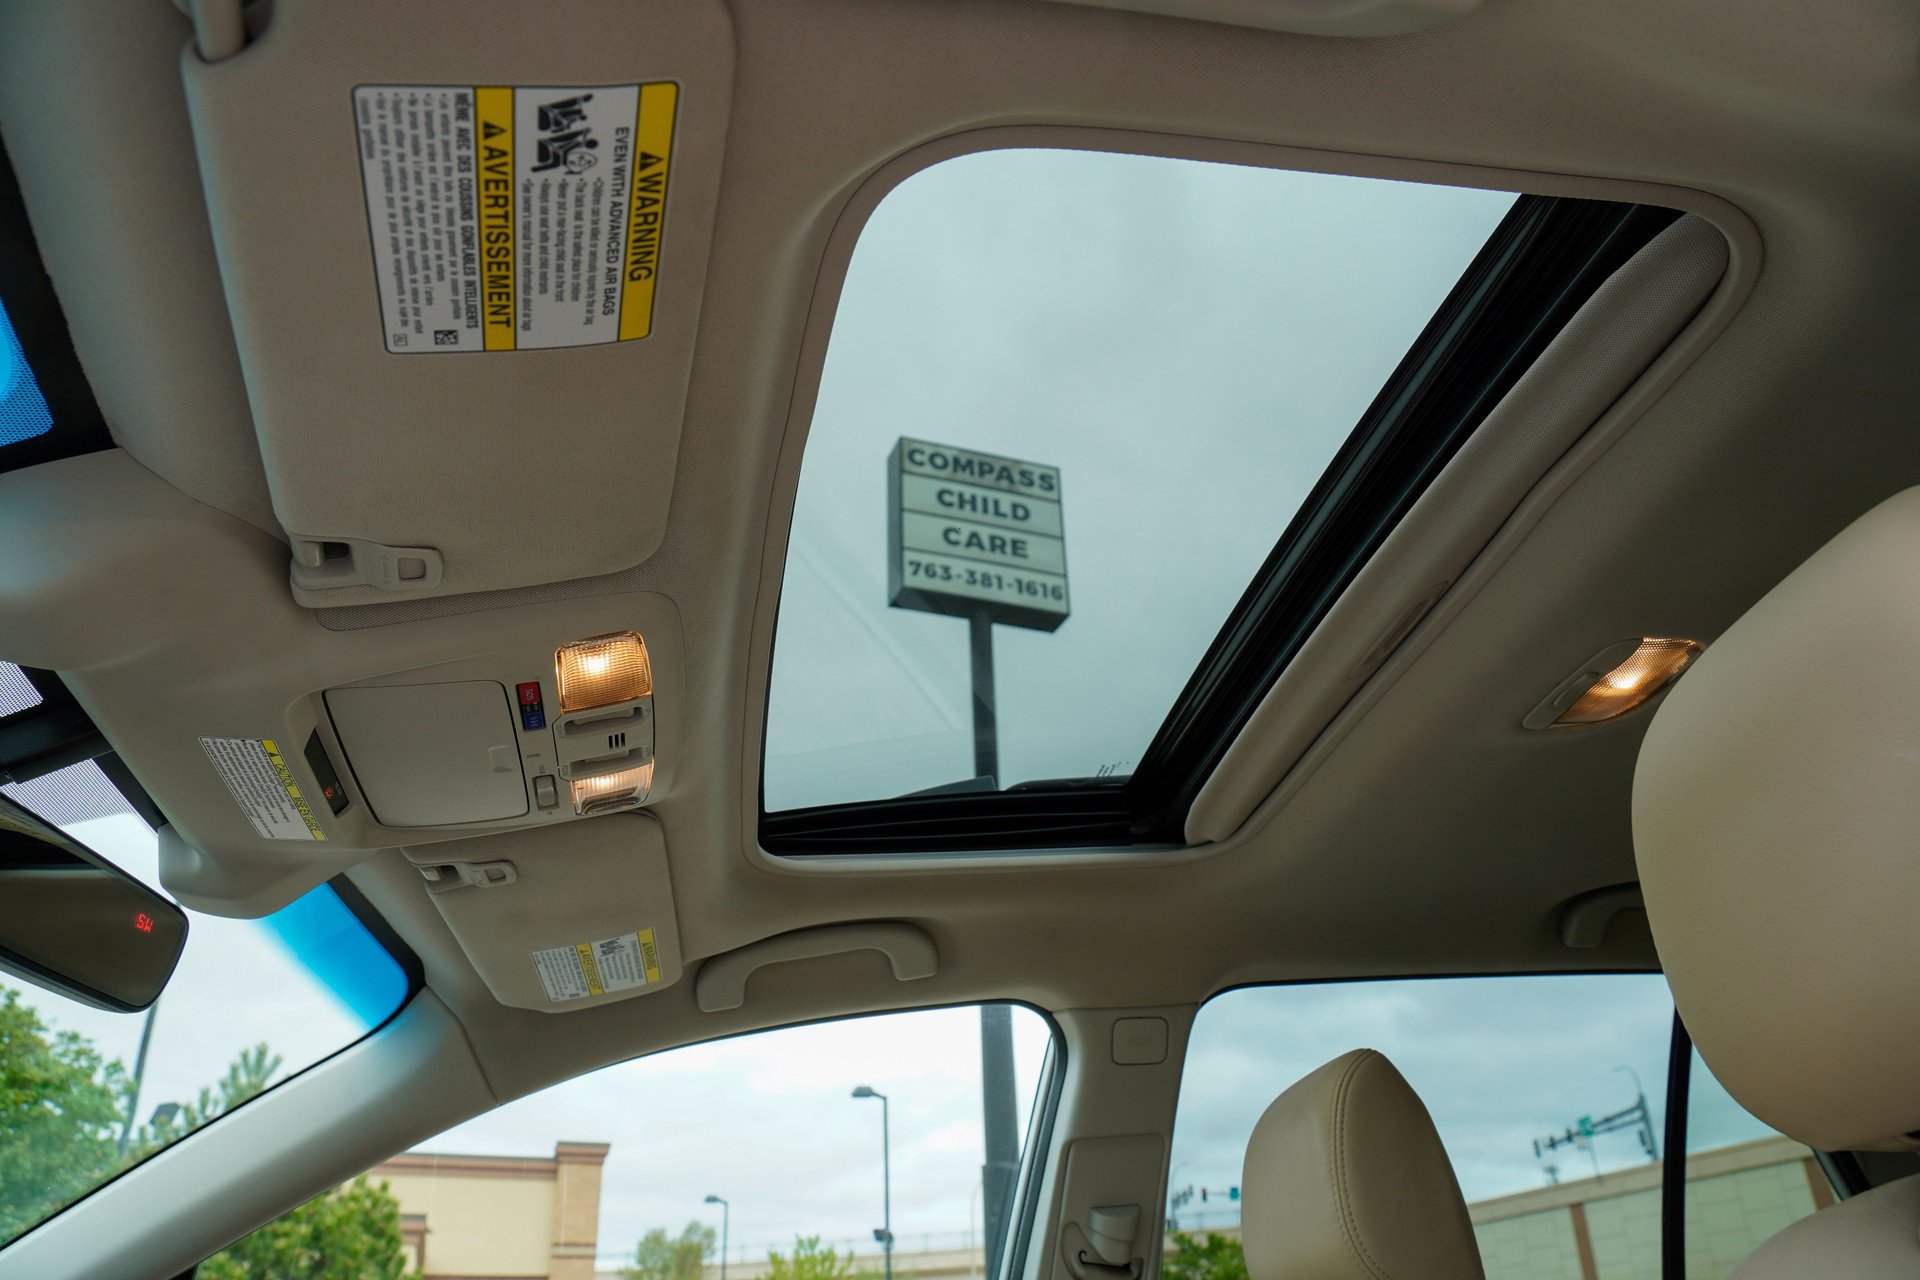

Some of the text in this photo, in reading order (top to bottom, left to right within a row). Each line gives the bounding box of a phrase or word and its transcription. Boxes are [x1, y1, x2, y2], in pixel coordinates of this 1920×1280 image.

[454, 126, 471, 150] AVEC
[456, 155, 472, 173] DES
[457, 177, 474, 221] COUSSINS
[482, 144, 511, 329] AVERTISSEMENT
[603, 126, 629, 315] EVEN WITH ADVANCED AIR BAGS
[628, 170, 663, 282] WARNING
[460, 224, 476, 275] GONFLABLES
[463, 279, 479, 329] INTELLIGENTS
[907, 448, 1055, 492] COMPASS
[937, 488, 1031, 521] CHILD
[942, 526, 1029, 558] CARE
[908, 560, 1064, 600] 763-381-1616
[525, 688, 534, 700] SOS
[275, 763, 295, 787] CAUTION
[302, 817, 320, 832] GARDE
[582, 952, 600, 991] AVERTISSEMENT
[642, 945, 657, 970] WARNING
